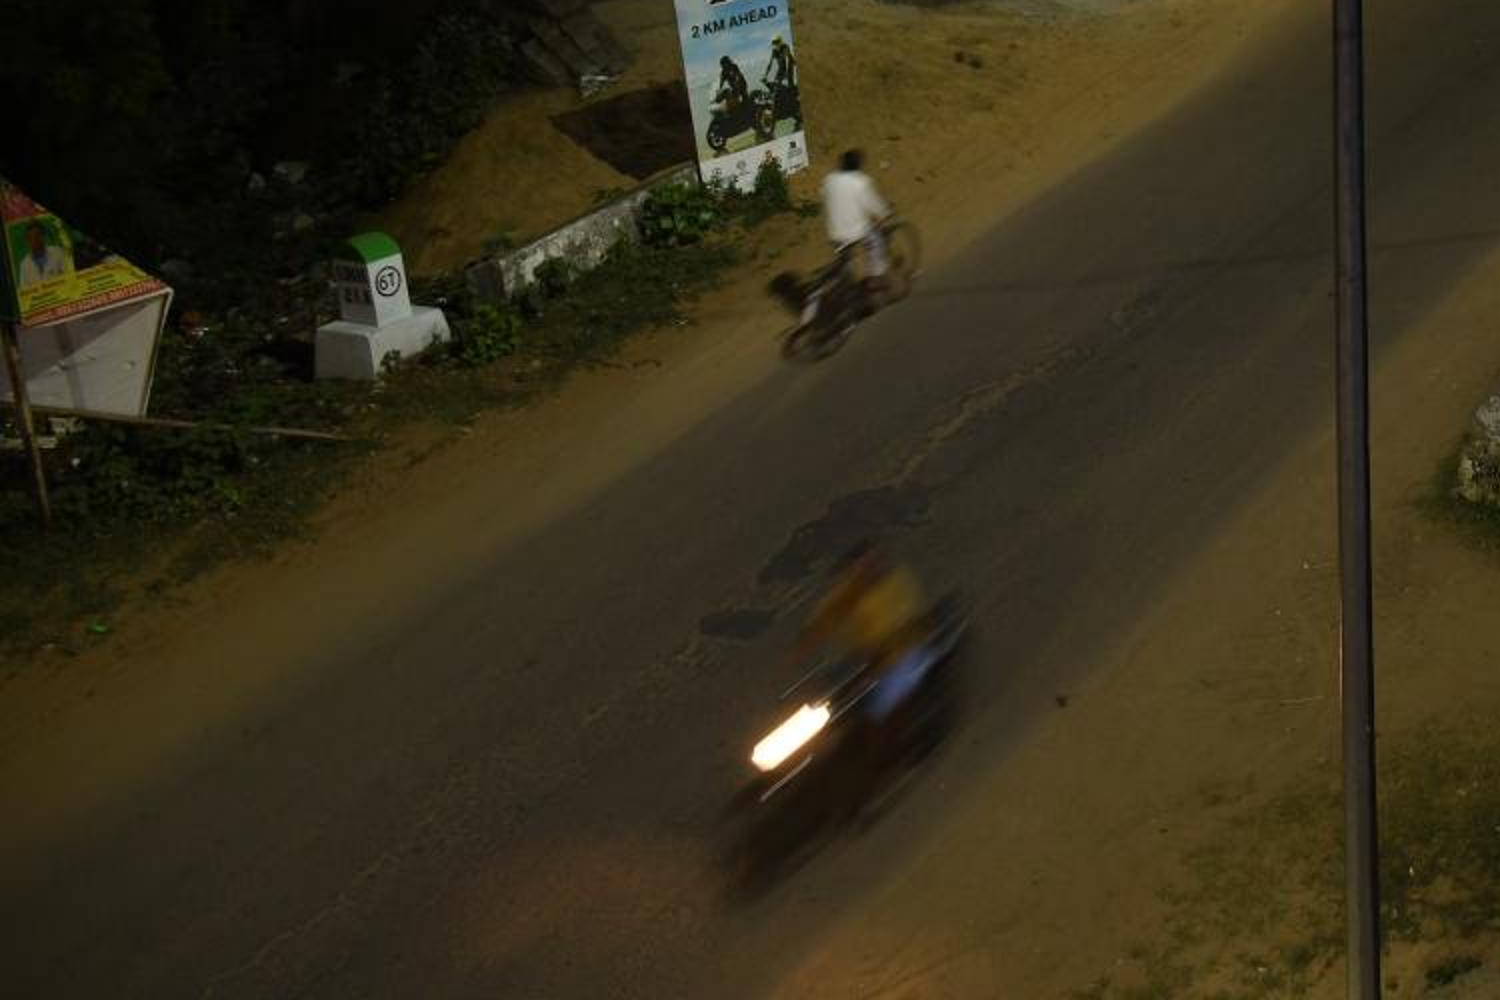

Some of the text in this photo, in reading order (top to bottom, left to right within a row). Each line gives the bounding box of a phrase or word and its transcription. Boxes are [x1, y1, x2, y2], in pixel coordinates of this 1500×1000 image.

[691, 5, 778, 39] 2 KM AHEAD
[379, 271, 396, 291] 67
